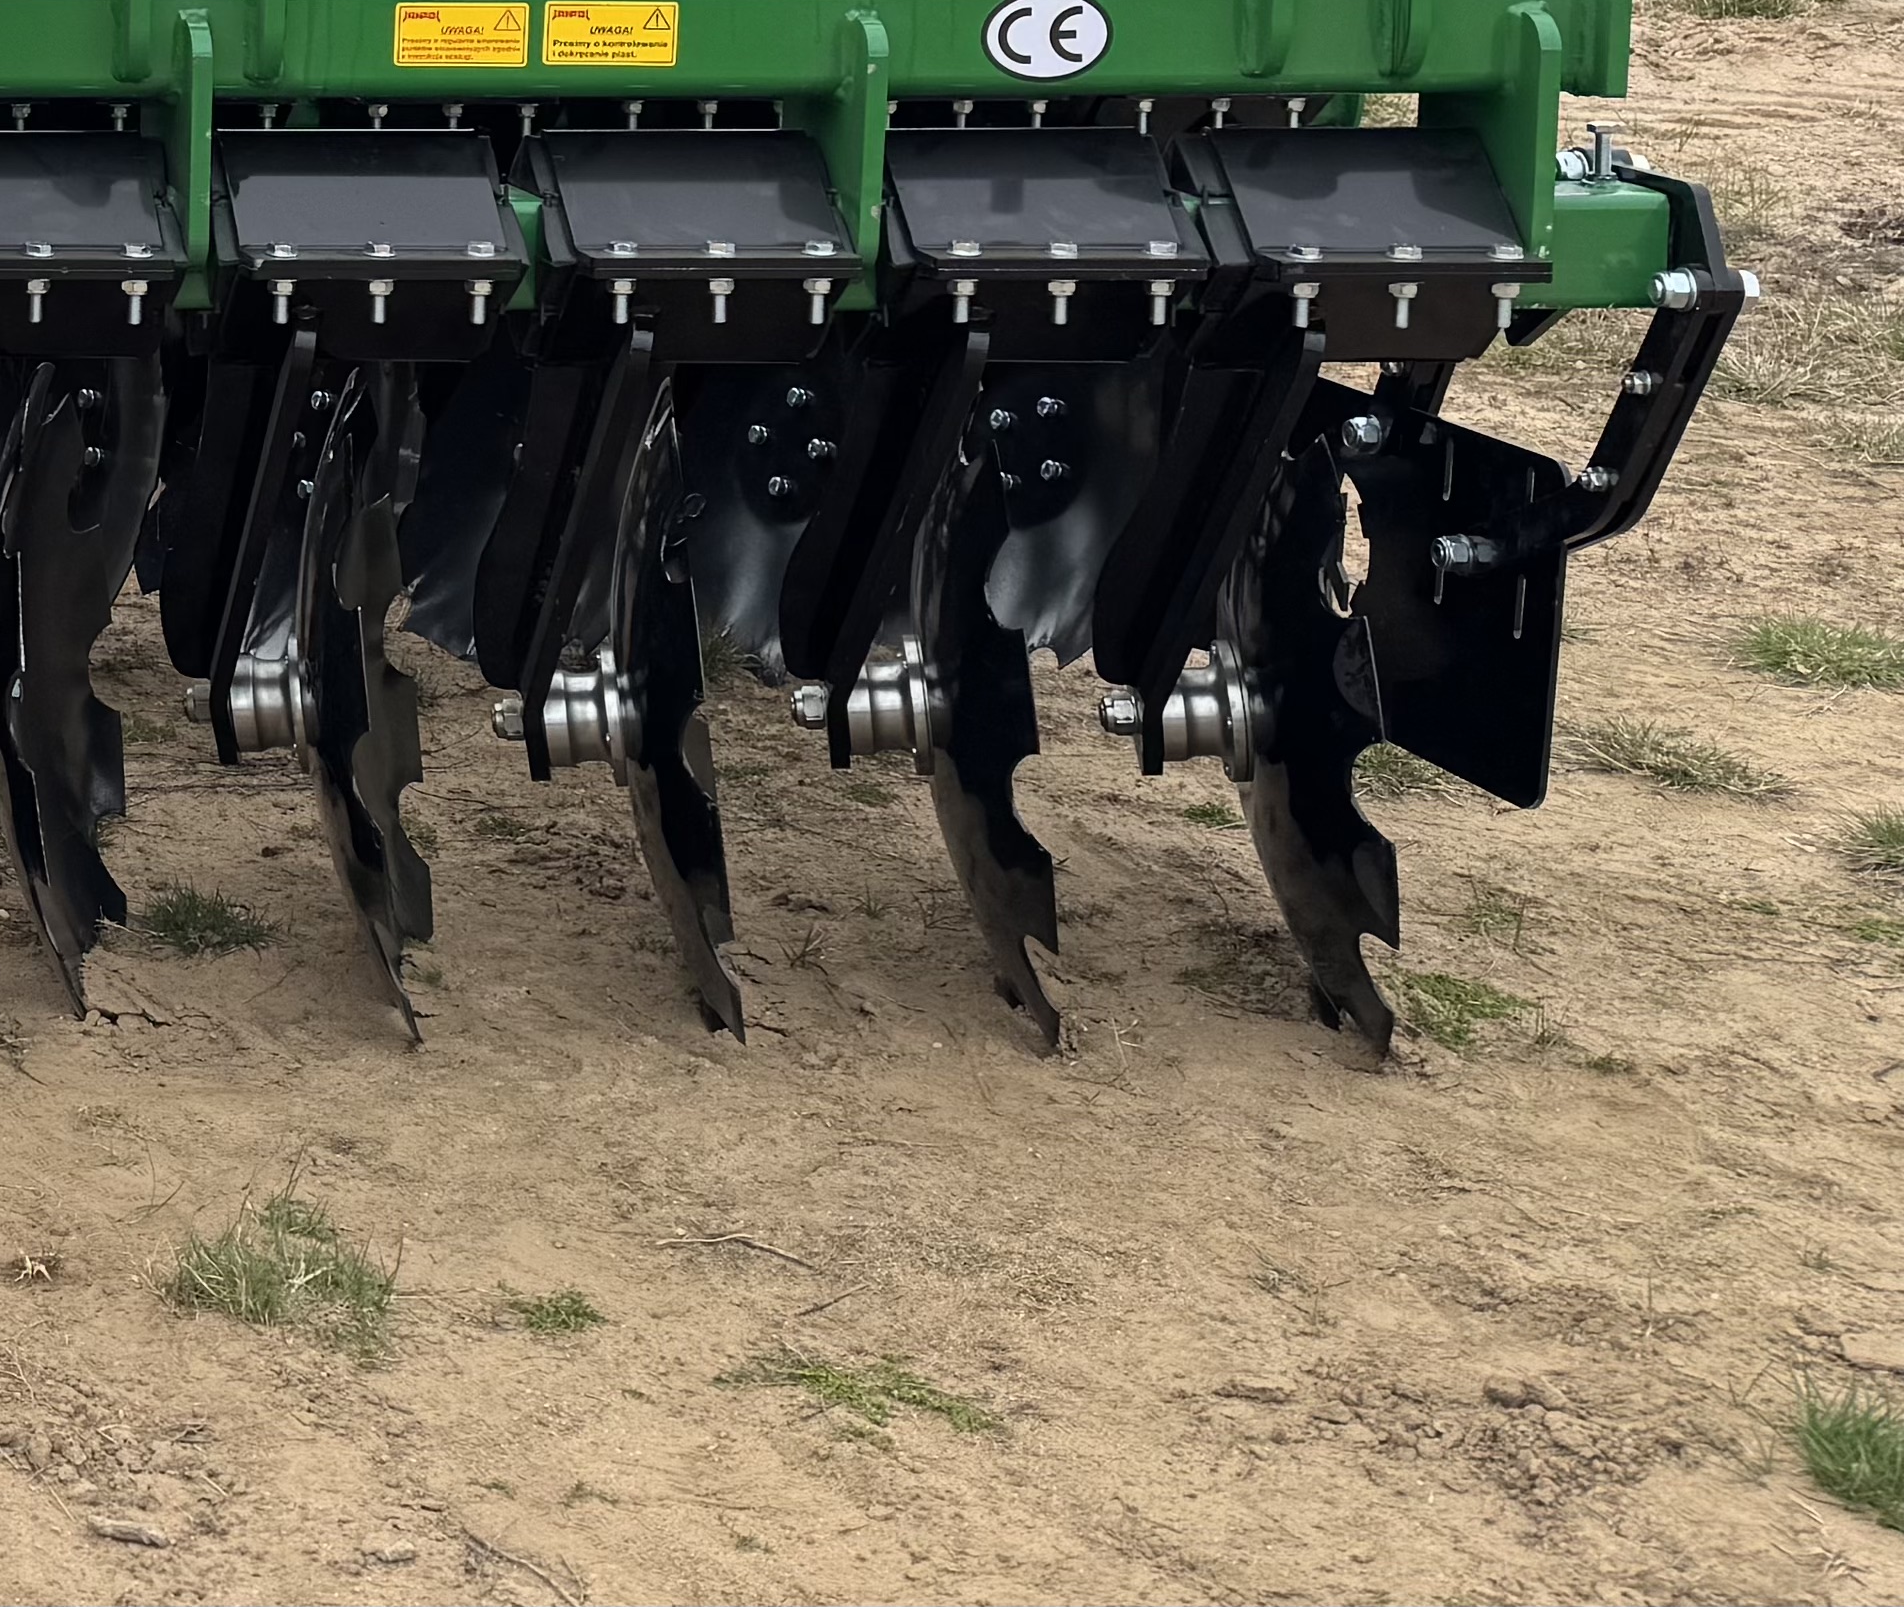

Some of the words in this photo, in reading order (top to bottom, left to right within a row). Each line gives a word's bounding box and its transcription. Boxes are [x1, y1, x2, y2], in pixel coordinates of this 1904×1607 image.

[440, 26, 485, 35] UWAGA!
[589, 25, 634, 35] UWAGA!
[997, 5, 1084, 65] CE
